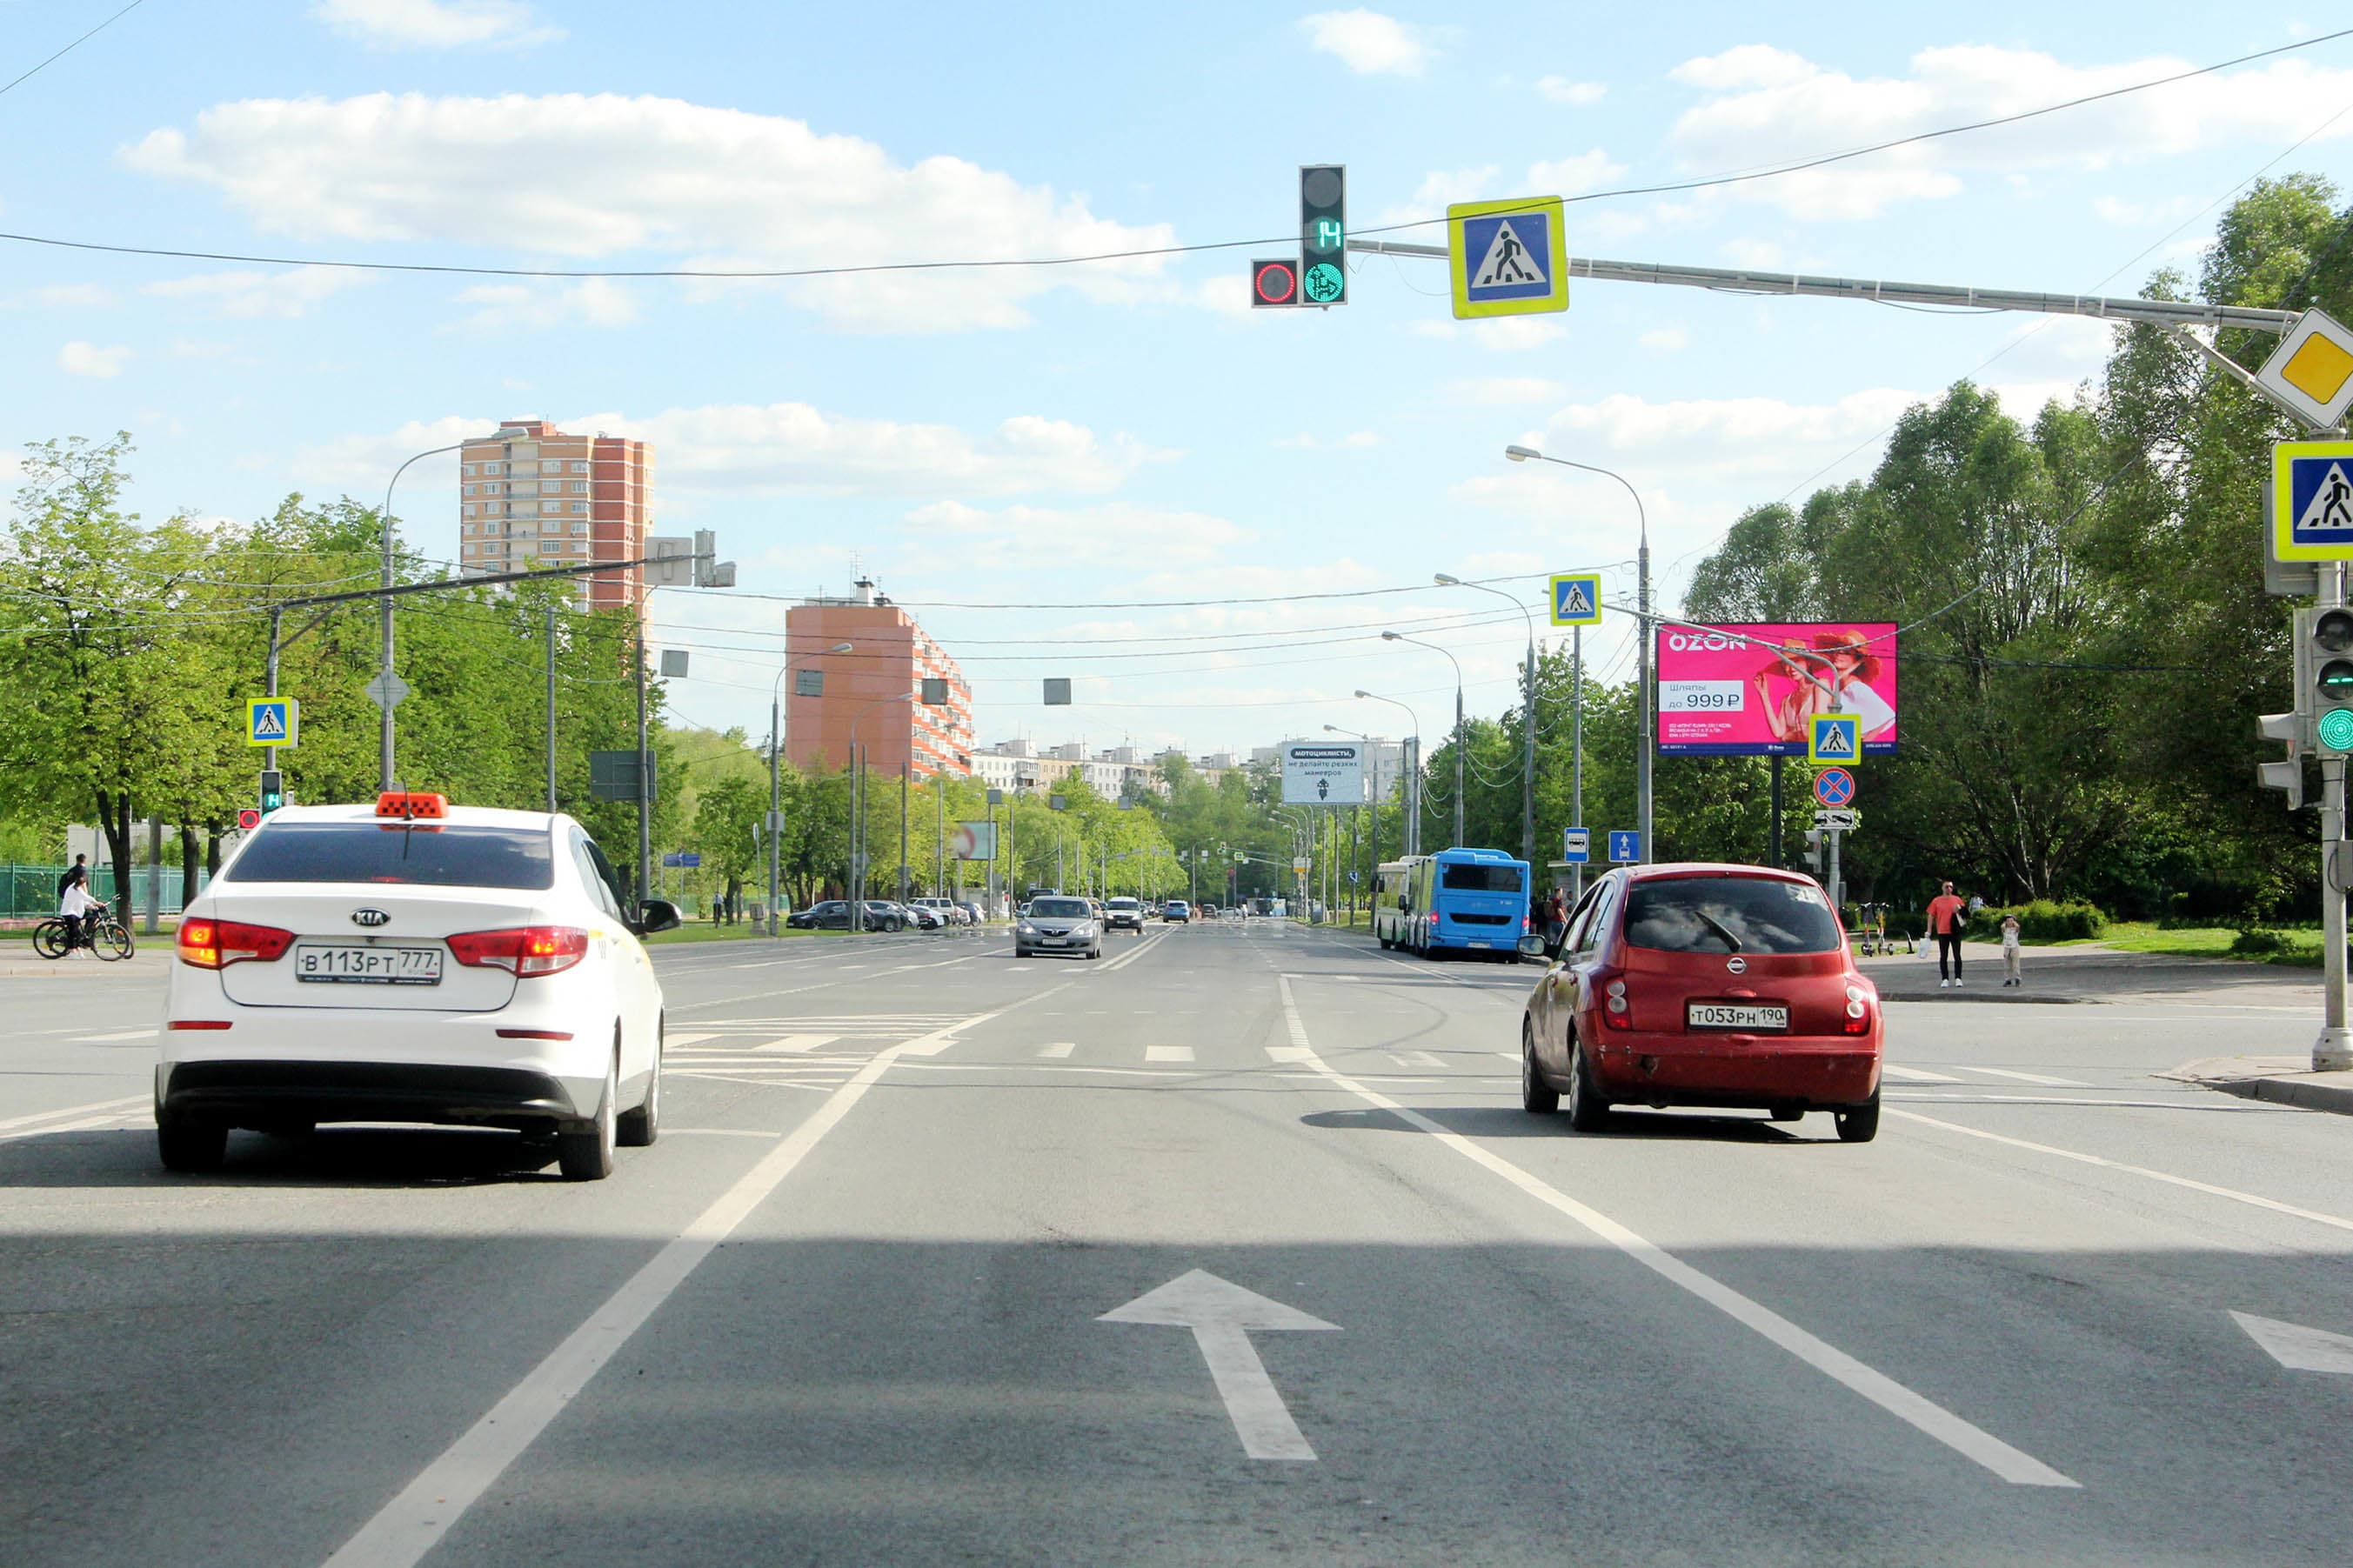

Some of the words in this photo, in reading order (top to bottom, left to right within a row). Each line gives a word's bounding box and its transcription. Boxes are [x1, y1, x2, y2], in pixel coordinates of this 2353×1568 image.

[1320, 221, 1341, 248] 14
[1668, 633, 1746, 651] OZON
[356, 911, 384, 924] KIA
